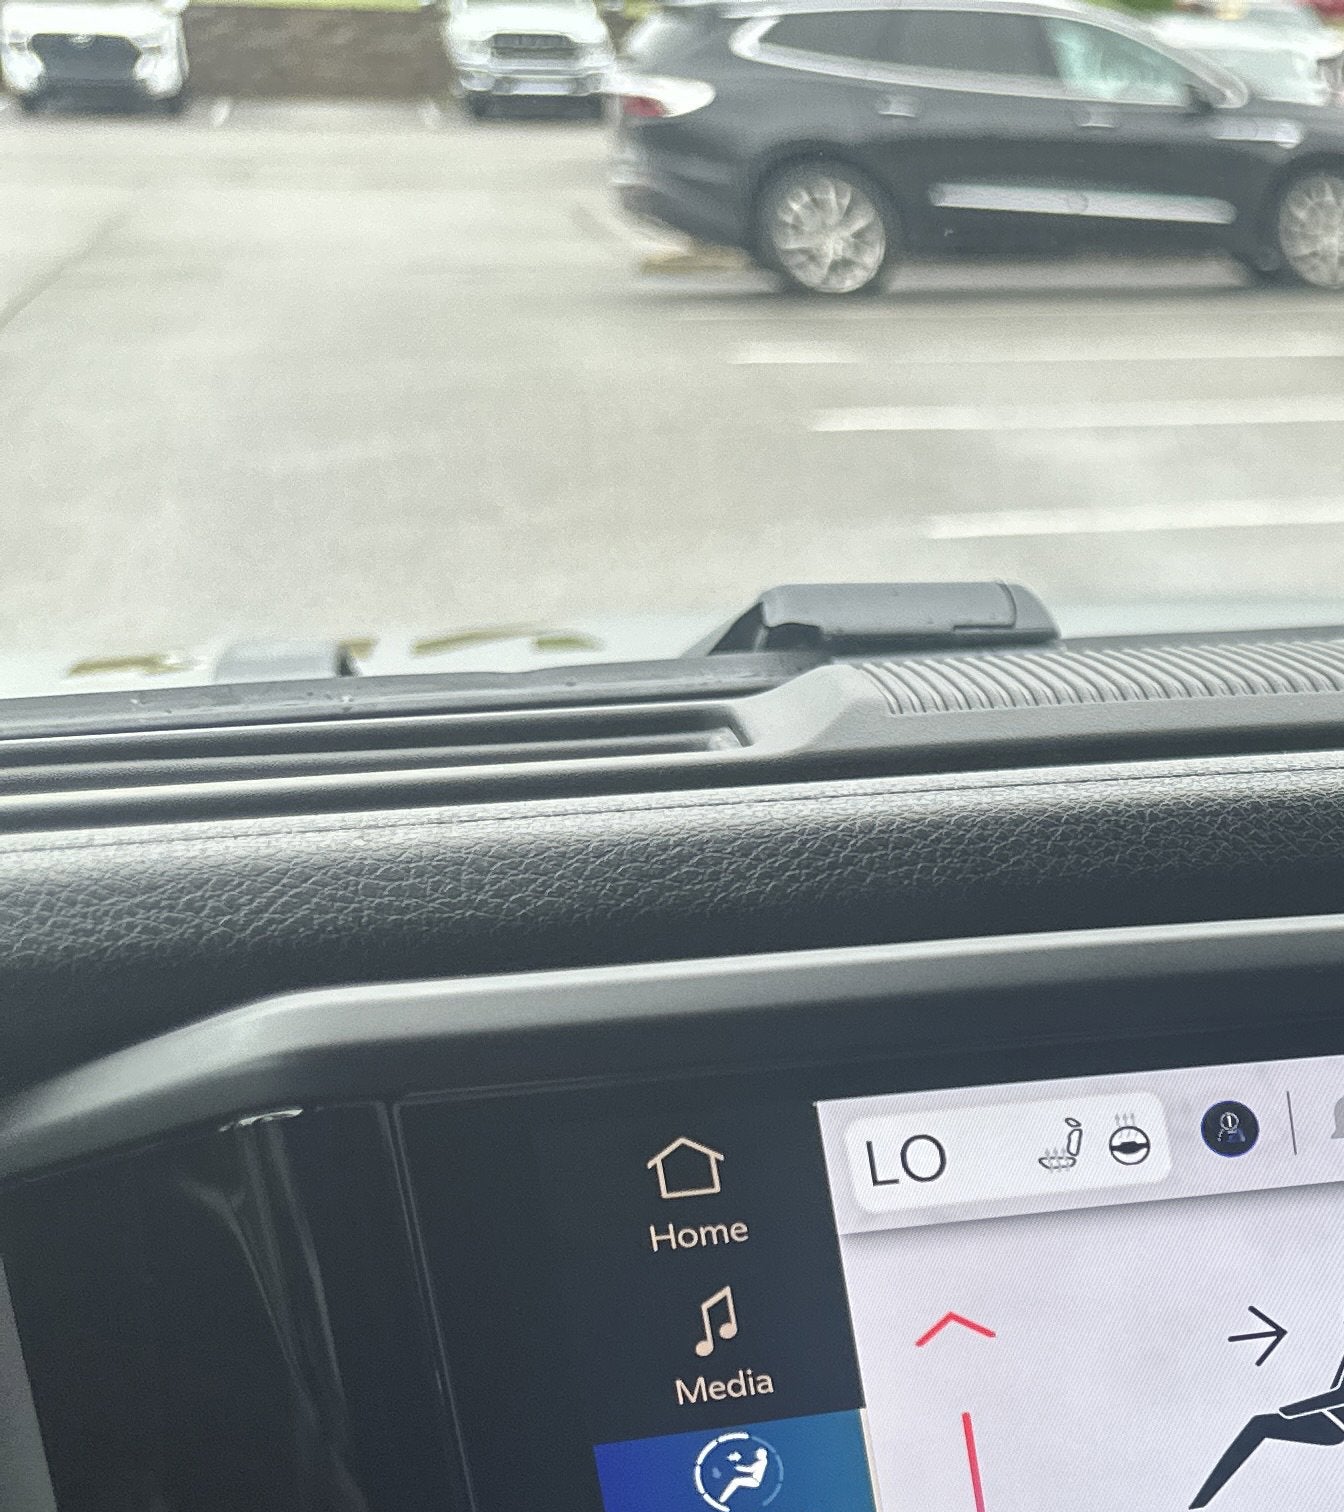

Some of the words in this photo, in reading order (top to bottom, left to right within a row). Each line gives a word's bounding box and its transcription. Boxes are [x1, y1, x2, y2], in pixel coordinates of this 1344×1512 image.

[866, 1134, 947, 1186] LO
[649, 1217, 749, 1252] Home
[675, 1370, 775, 1405] Media
